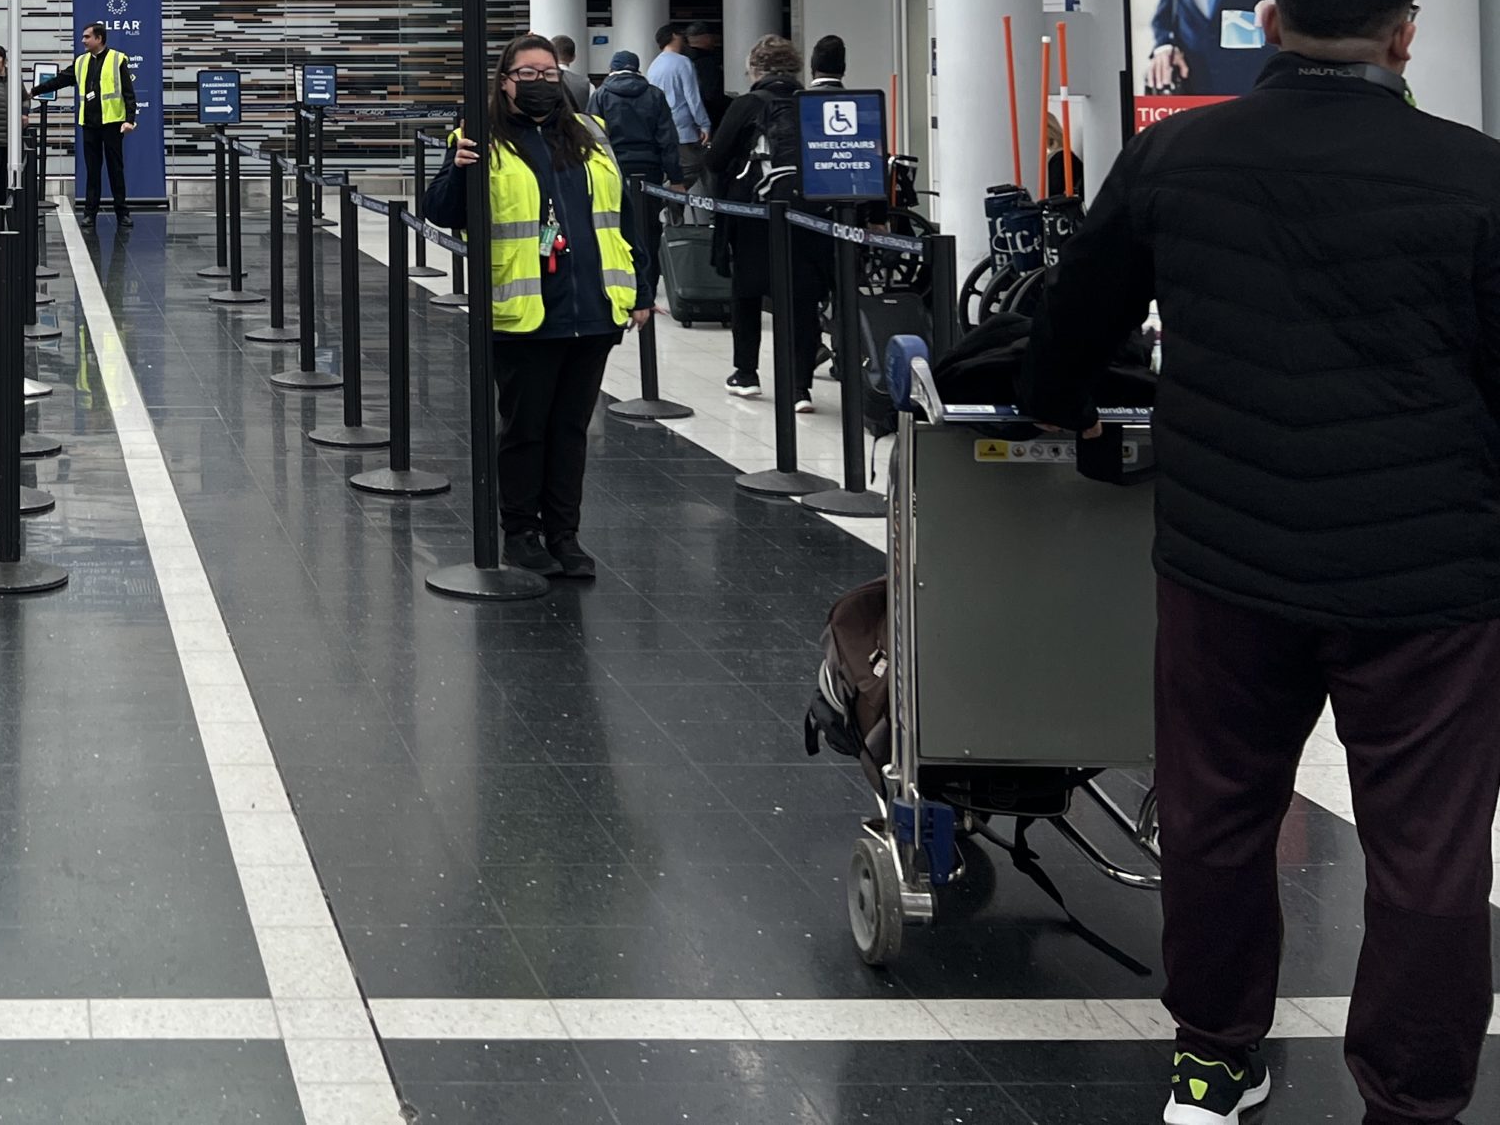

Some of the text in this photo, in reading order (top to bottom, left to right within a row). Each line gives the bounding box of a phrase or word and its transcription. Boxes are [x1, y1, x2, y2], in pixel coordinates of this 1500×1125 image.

[807, 140, 876, 150] WHEELCHAIRS
[831, 151, 853, 160] AND
[813, 161, 871, 170] EMPLOYEES
[832, 222, 865, 244] CHICAGO
